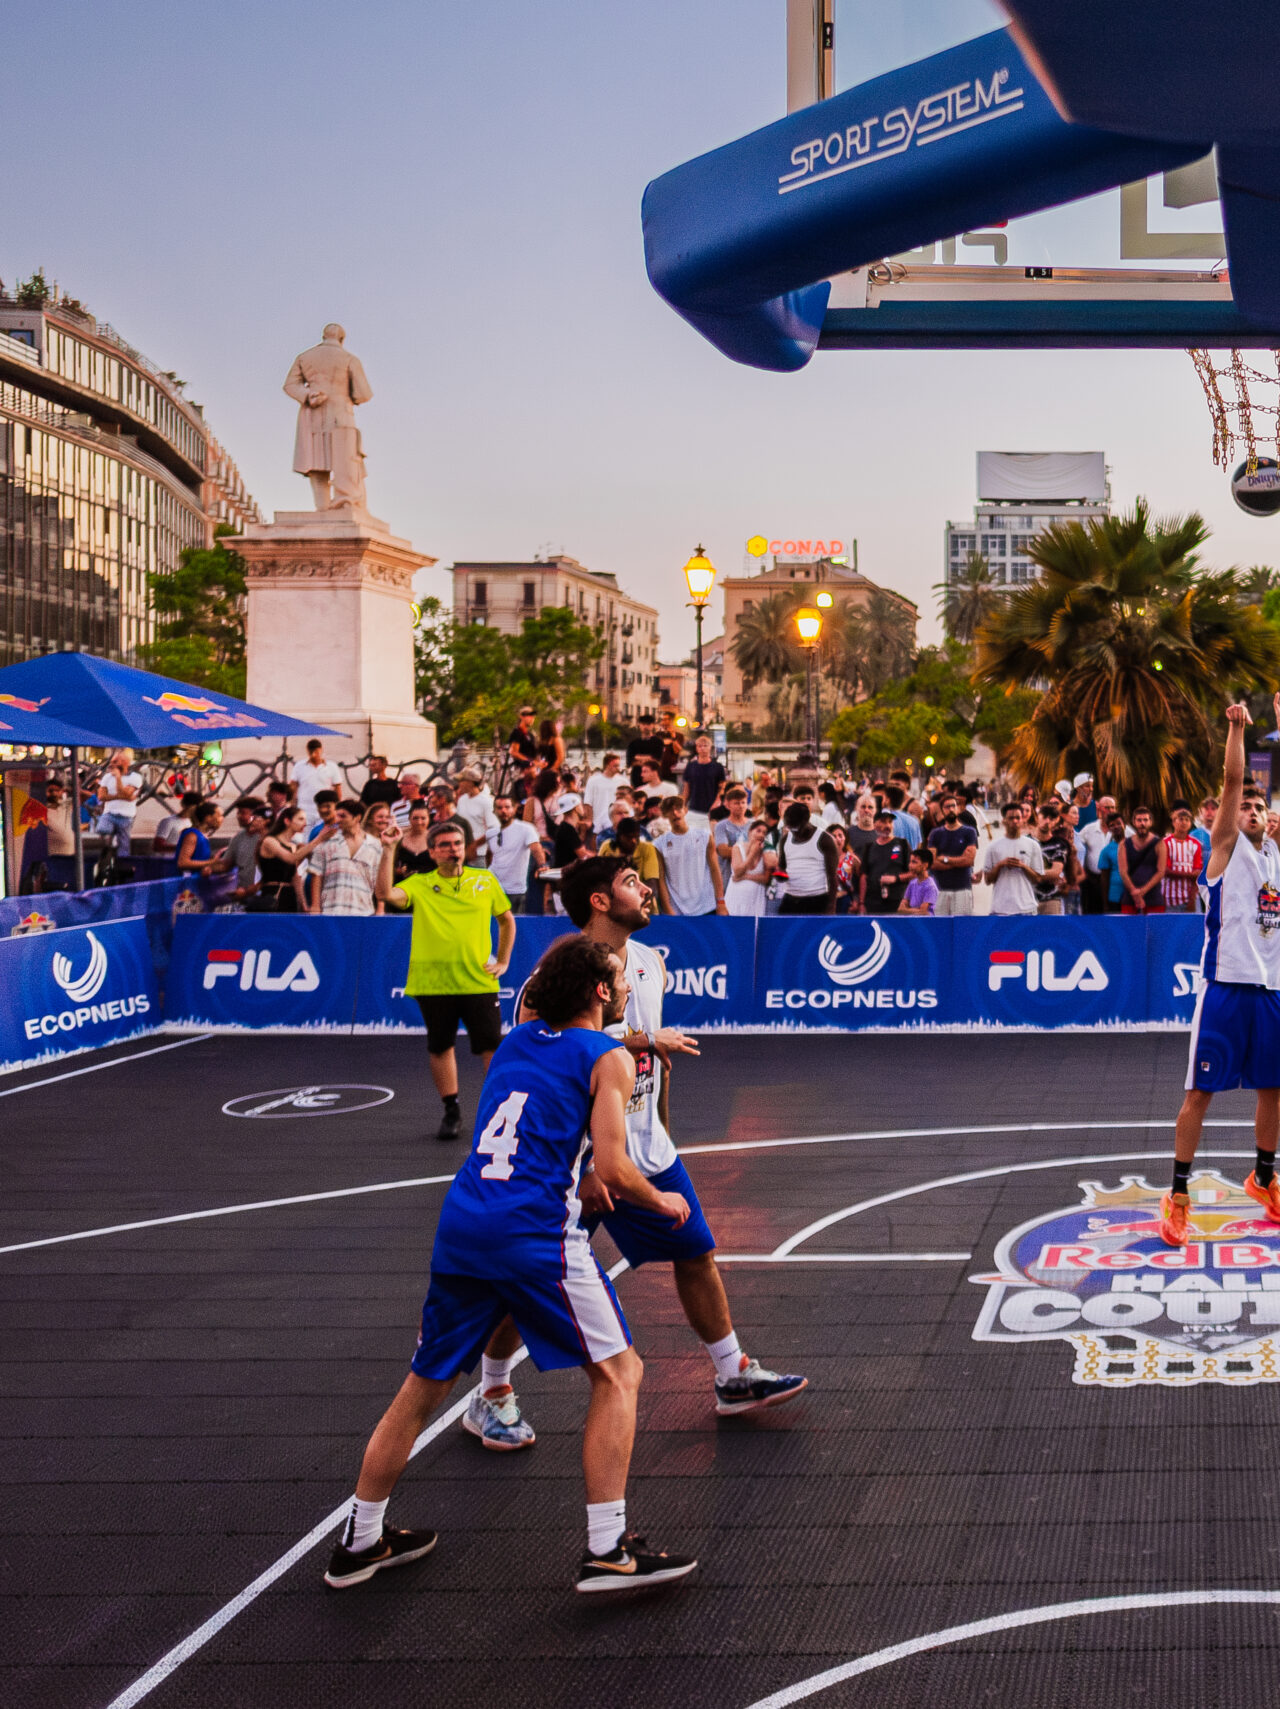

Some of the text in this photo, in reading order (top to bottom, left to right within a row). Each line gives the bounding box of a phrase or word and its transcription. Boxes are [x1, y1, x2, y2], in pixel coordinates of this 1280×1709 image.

[778, 116, 879, 184] SPORT
[769, 540, 843, 555] CONAD
[203, 949, 320, 992] FILA
[988, 950, 1109, 991] FILA
[24, 995, 151, 1040] ECOPNEUS
[765, 989, 938, 1009] ECOPNEUS
[477, 1091, 529, 1180] 4
[1038, 1244, 1203, 1270] Red
[1183, 1325, 1237, 1333] ITALY
